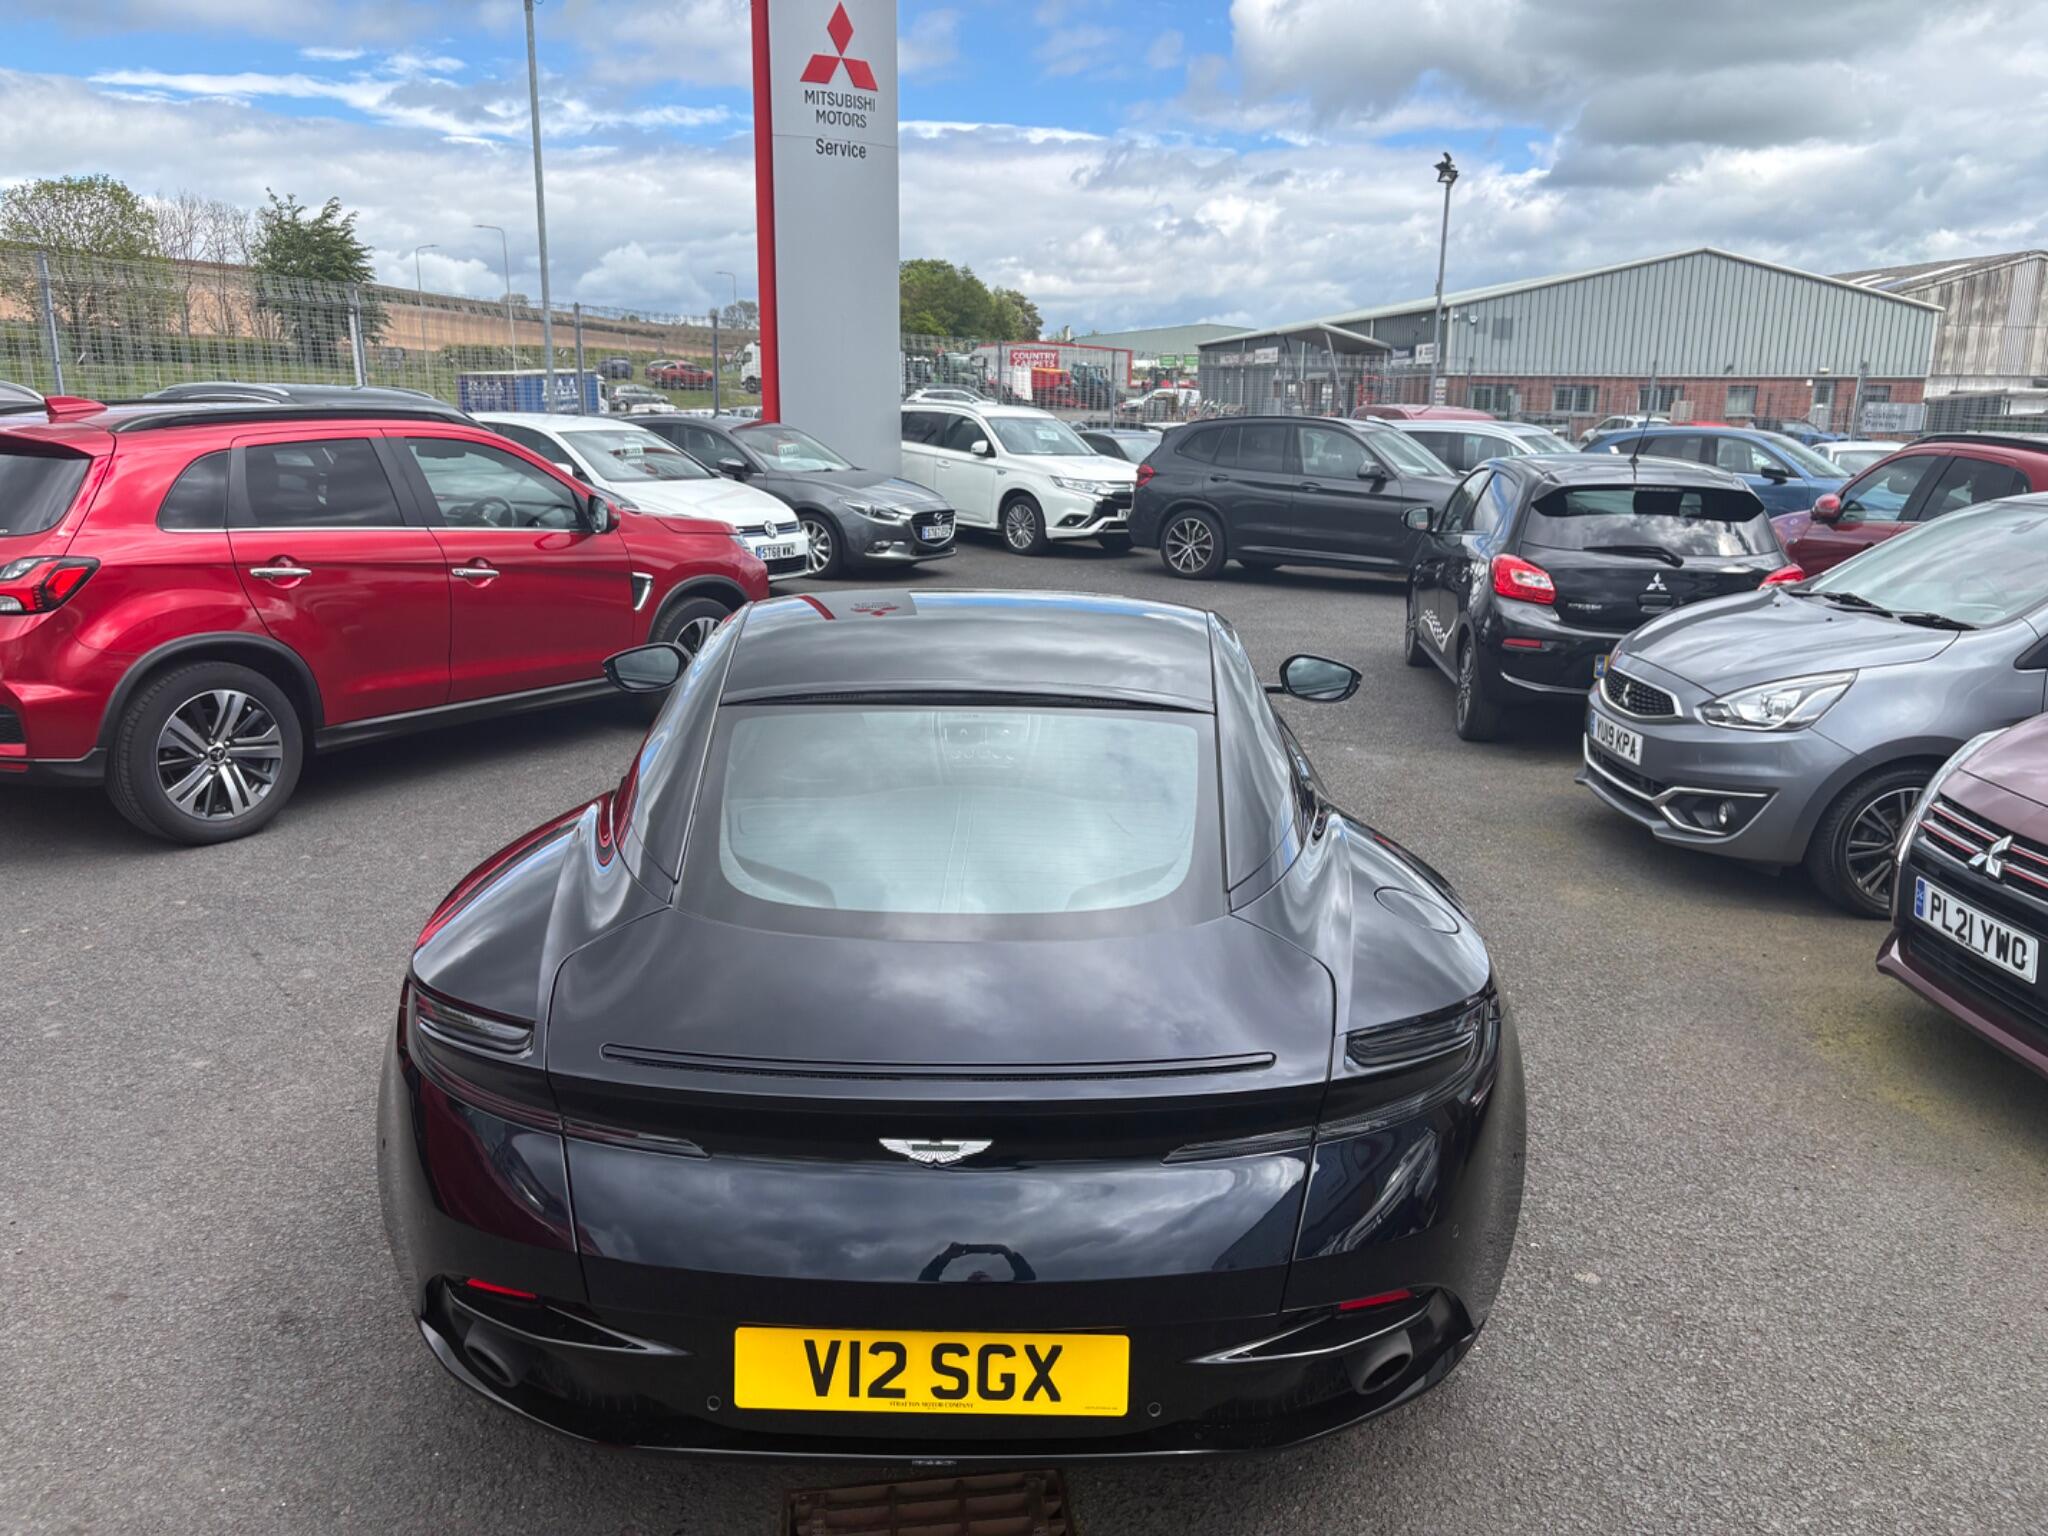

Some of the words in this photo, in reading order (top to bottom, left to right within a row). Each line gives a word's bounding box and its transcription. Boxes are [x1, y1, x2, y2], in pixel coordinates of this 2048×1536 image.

[804, 90, 876, 112] MITSUBISHI
[815, 110, 867, 128] MOTORS
[815, 138, 867, 159] Service
[1012, 352, 1057, 361] COUNTRY
[1865, 411, 1906, 419] Customer
[1865, 420, 1897, 429] Parking
[1616, 728, 1636, 760] KPA
[930, 1342, 1064, 1402] SGX
